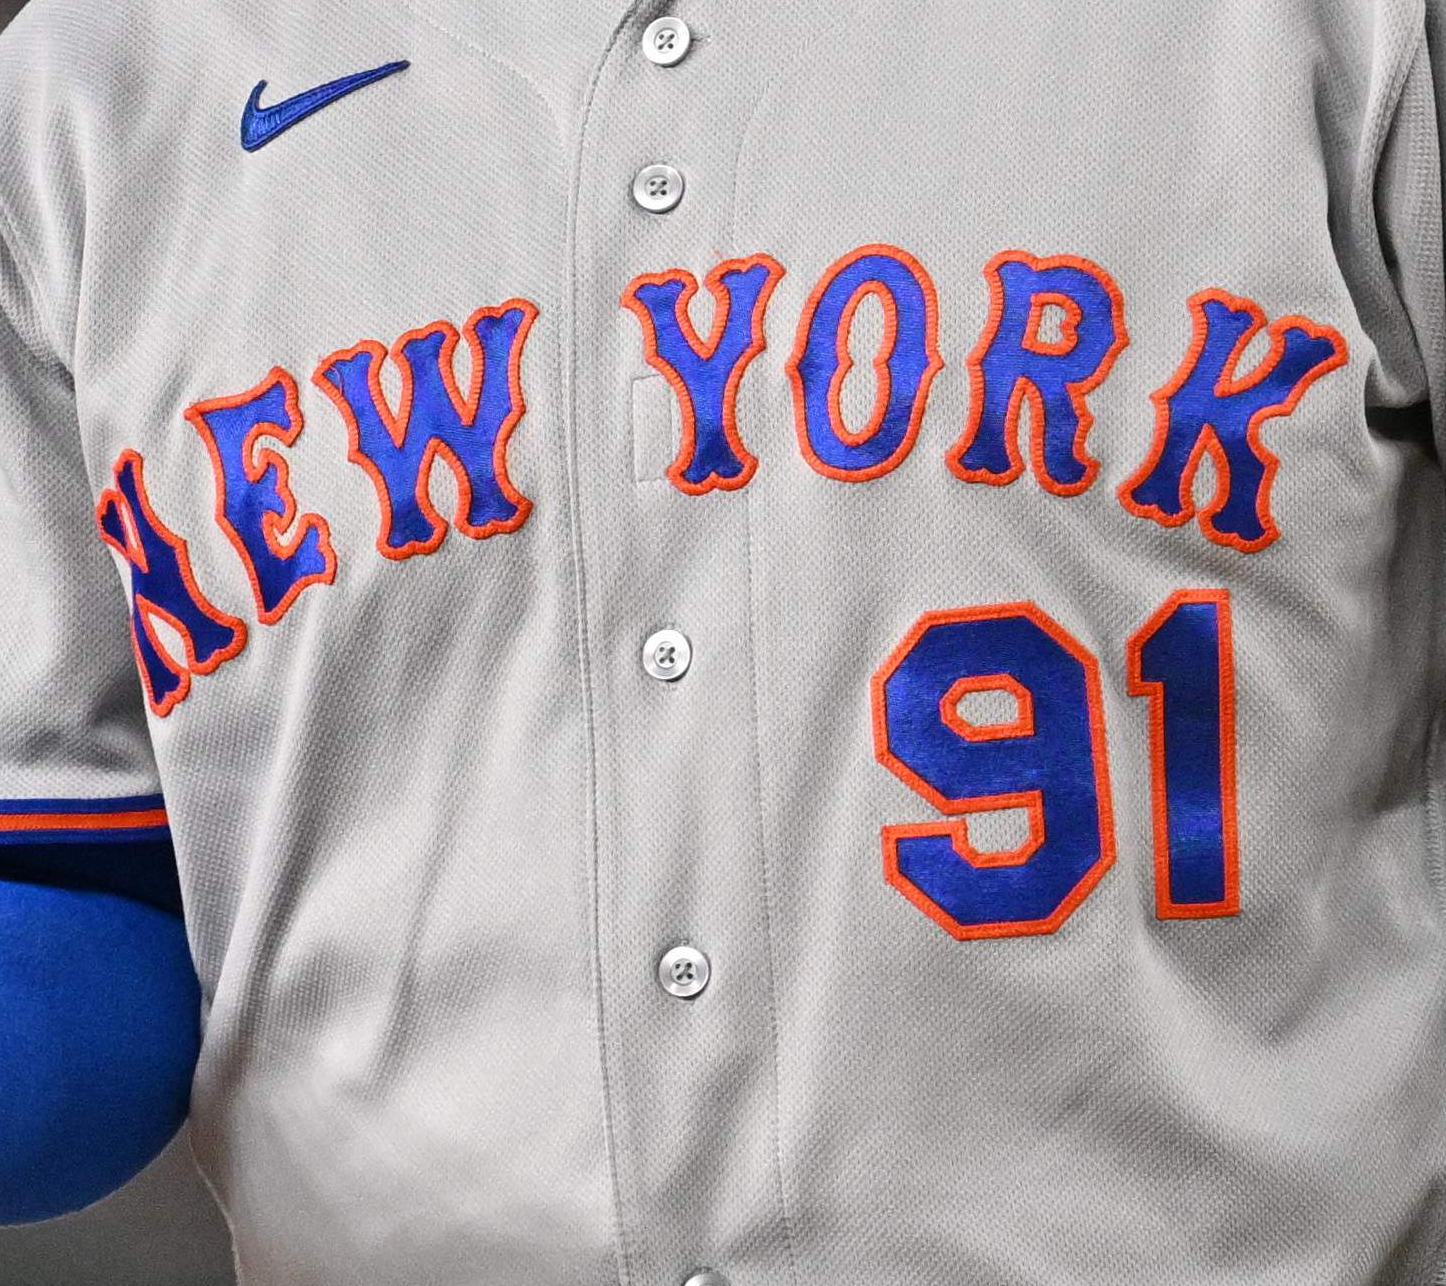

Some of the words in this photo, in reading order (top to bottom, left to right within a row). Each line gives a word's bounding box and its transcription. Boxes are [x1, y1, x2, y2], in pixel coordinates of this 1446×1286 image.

[97, 298, 540, 717] NEW
[620, 243, 1348, 553] YORK
[871, 588, 1241, 941] 91
